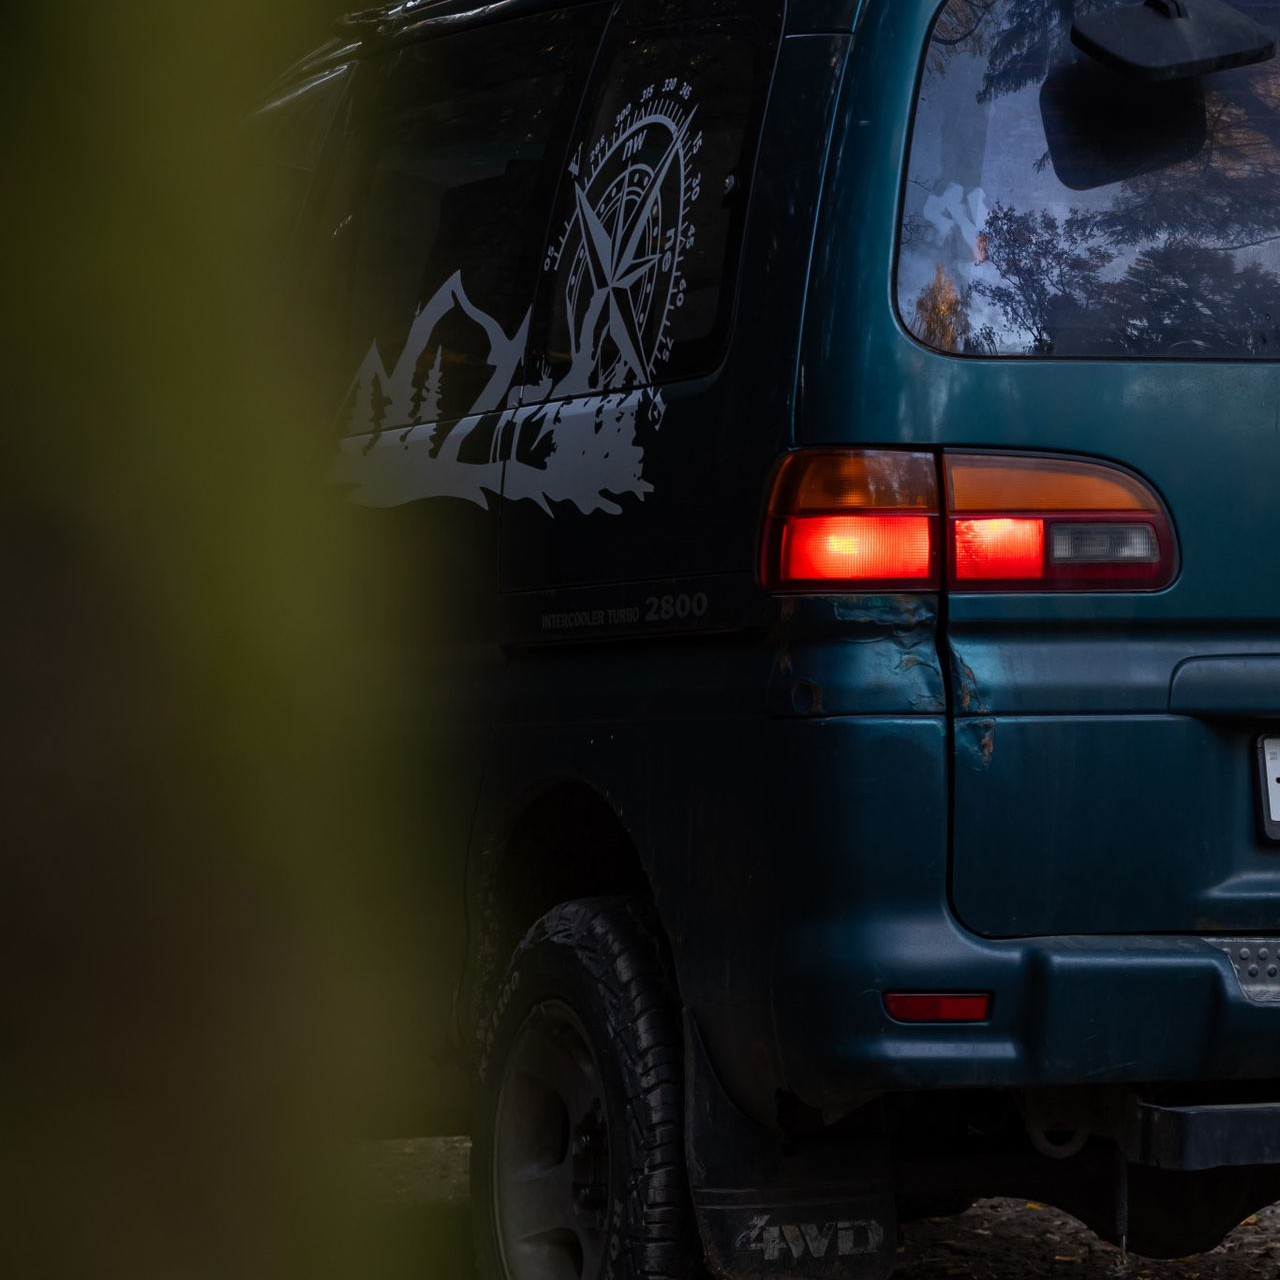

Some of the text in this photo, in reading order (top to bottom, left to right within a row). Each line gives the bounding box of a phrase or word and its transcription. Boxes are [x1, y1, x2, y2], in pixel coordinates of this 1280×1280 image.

[640, 84, 655, 103] 315
[662, 77, 678, 92] 330
[679, 82, 692, 100] 345
[614, 103, 632, 127] 300
[692, 130, 703, 154] 15
[691, 172, 702, 201] 30
[686, 223, 696, 250] 45
[676, 278, 687, 307] 60
[661, 336, 674, 363] 75
[542, 591, 708, 630] INTERCOOLER TURBO 2800
[733, 1214, 885, 1261] 4WD
